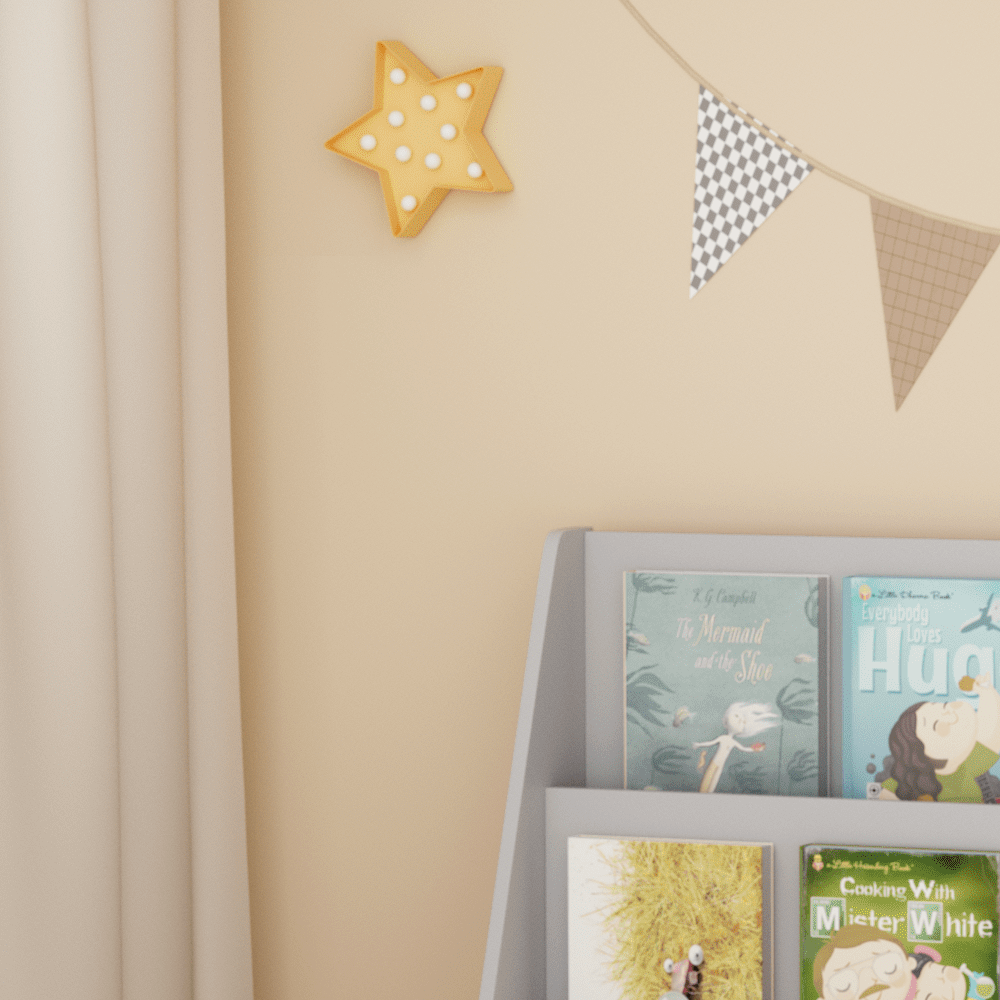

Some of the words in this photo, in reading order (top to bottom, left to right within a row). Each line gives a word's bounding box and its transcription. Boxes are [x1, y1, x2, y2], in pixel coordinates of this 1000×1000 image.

[861, 602, 929, 626] Everybody
[675, 616, 695, 641] The
[691, 613, 771, 647] Mermaid
[906, 624, 942, 644] Loves
[694, 650, 718, 669] and
[717, 649, 737, 672] the
[734, 649, 774, 686] Shoe
[839, 875, 907, 902] Cooking
[908, 878, 956, 901] With
[910, 908, 994, 939] White
